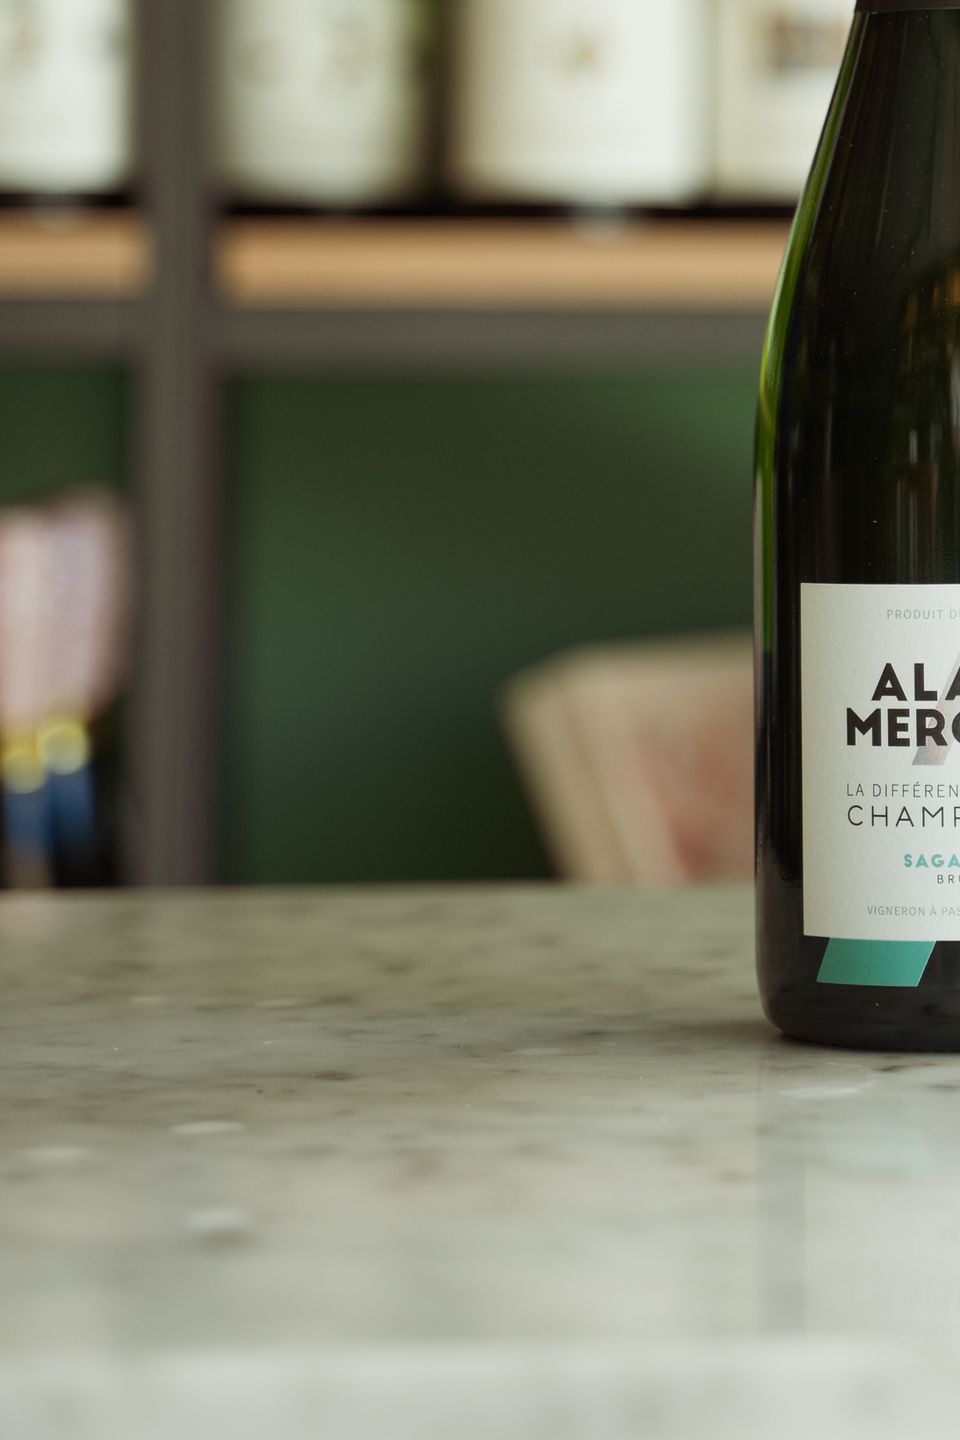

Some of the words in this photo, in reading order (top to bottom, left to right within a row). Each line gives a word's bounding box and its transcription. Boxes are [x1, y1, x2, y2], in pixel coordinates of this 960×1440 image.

[886, 609, 944, 620] PRODUIT
[846, 783, 864, 797] LA
[866, 904, 926, 916] VIGNERON
[930, 903, 937, 916] À
